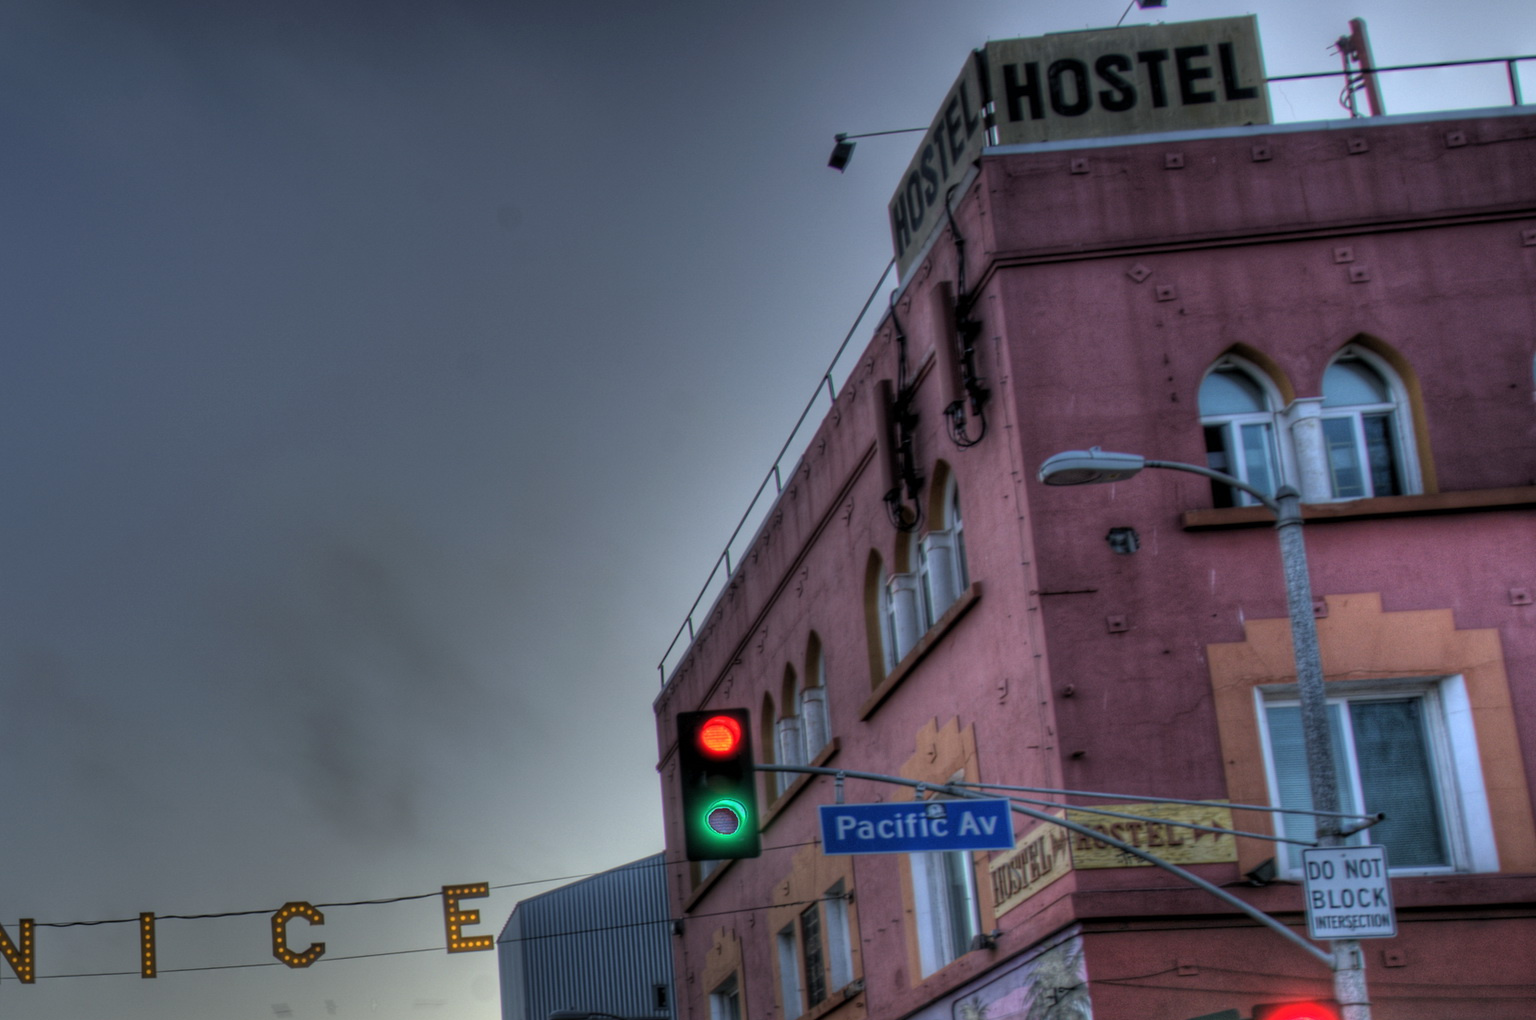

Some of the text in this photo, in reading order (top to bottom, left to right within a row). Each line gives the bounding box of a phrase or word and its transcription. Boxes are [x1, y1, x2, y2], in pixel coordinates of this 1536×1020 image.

[1002, 42, 1259, 123] HOSTEL
[893, 80, 980, 259] HOSTEL
[836, 811, 998, 841] Pacific Av
[1075, 821, 1184, 851] HOSTEL
[991, 835, 1052, 908] HOSTEL
[1308, 858, 1381, 880] DO NOT
[1312, 887, 1388, 909] BLOCK
[1315, 913, 1390, 929] INTERSECTION
